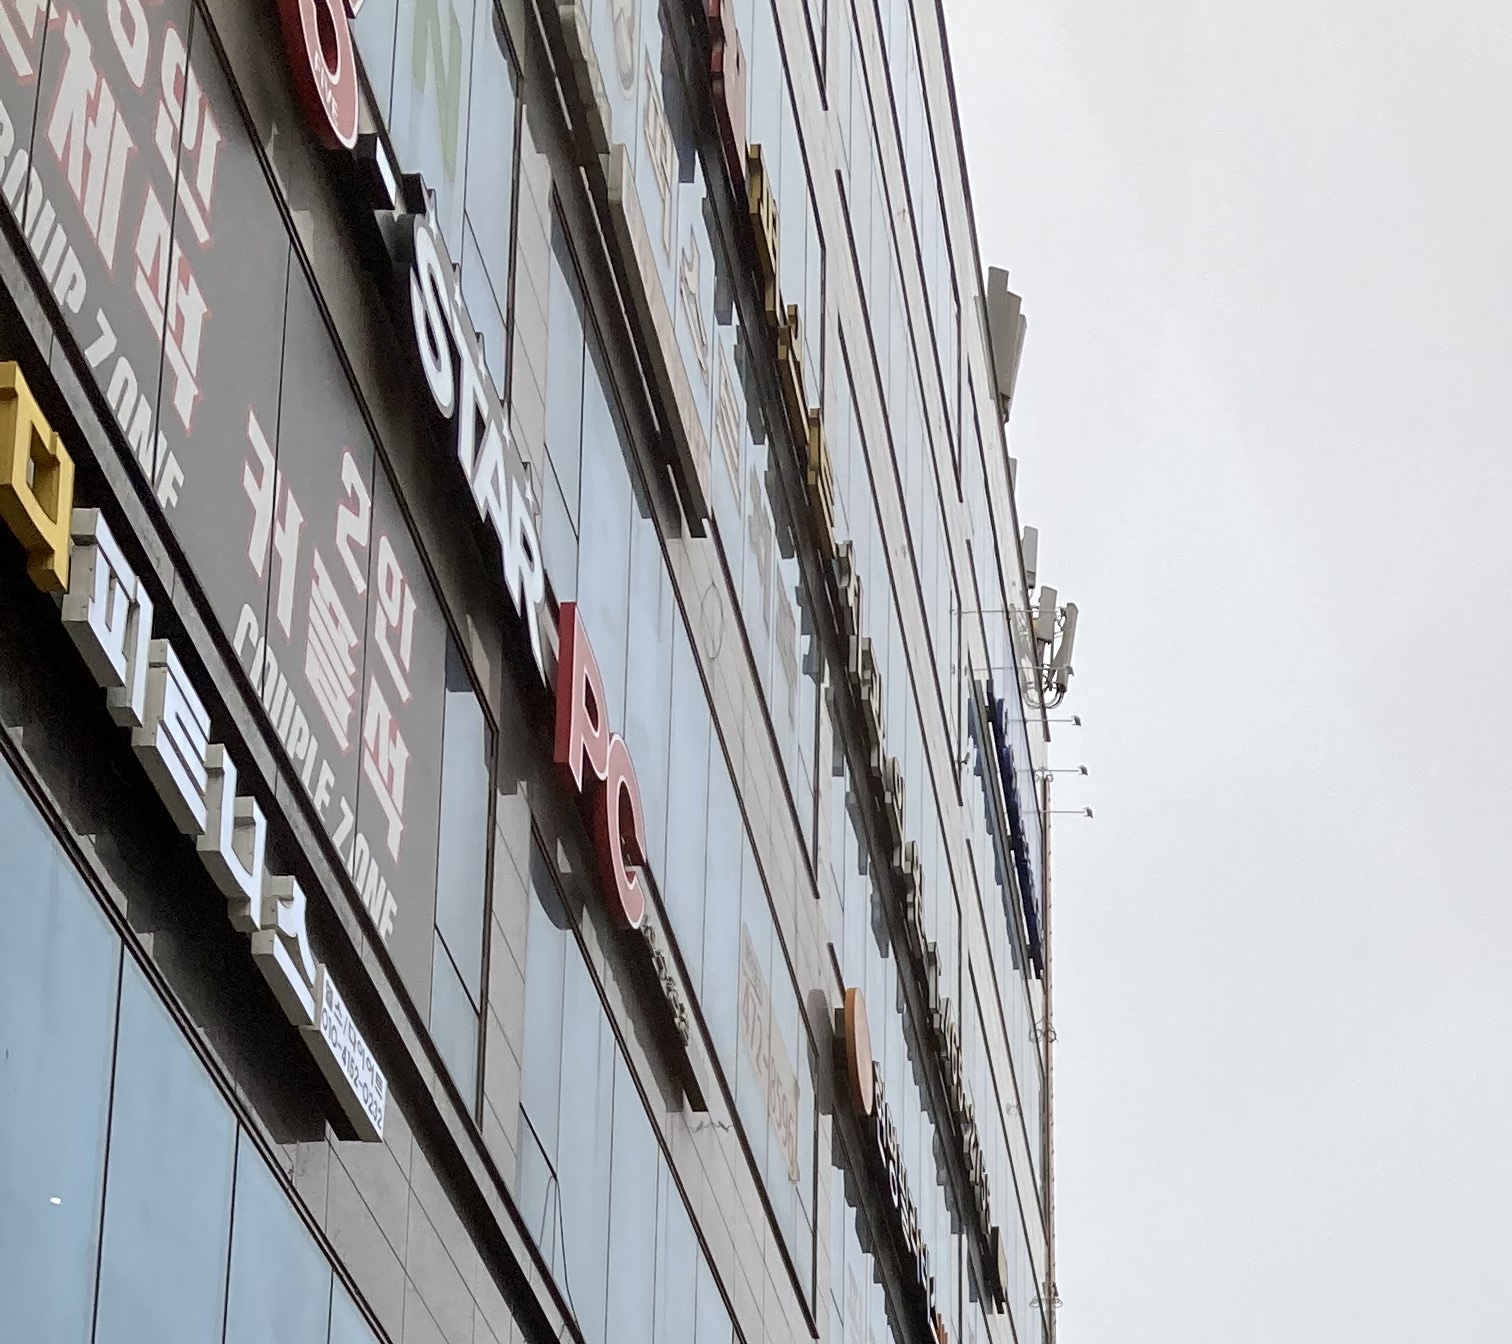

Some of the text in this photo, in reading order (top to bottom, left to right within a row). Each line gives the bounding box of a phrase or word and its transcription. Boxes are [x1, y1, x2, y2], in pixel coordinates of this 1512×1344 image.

[243, 408, 411, 862] 커플석
[335, 450, 417, 702] 2인
[409, 212, 650, 932] STAR PC
